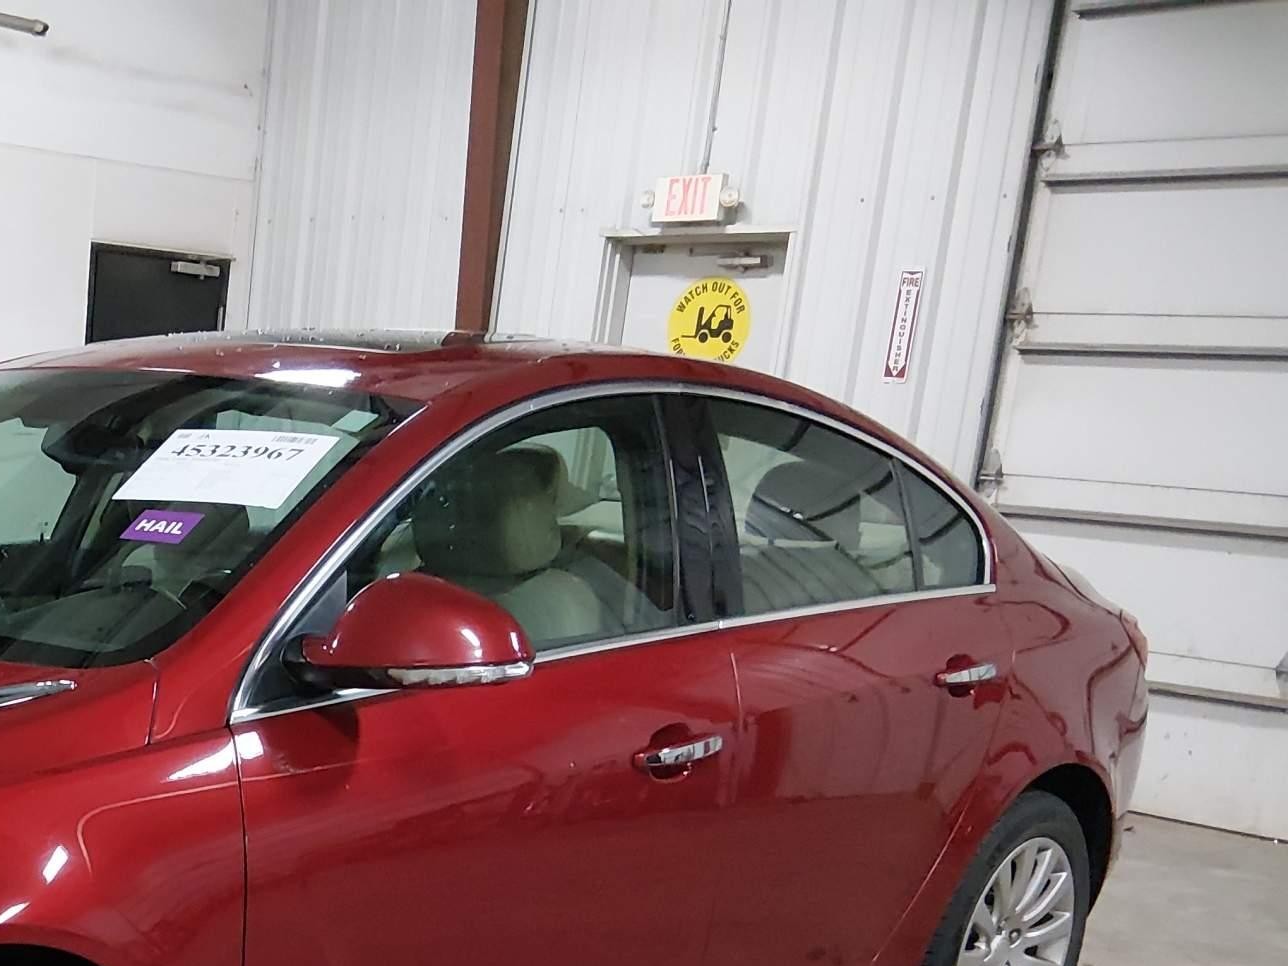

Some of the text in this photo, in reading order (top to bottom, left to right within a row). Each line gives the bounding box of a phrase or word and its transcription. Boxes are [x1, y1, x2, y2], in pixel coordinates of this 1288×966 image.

[665, 176, 711, 216] EXIT
[901, 277, 919, 287] FIRE
[676, 281, 745, 314] WATCH OUT FOR
[892, 289, 912, 371] EXTINGUISHER
[171, 444, 304, 461] 45323967
[135, 519, 183, 535] HAIL
